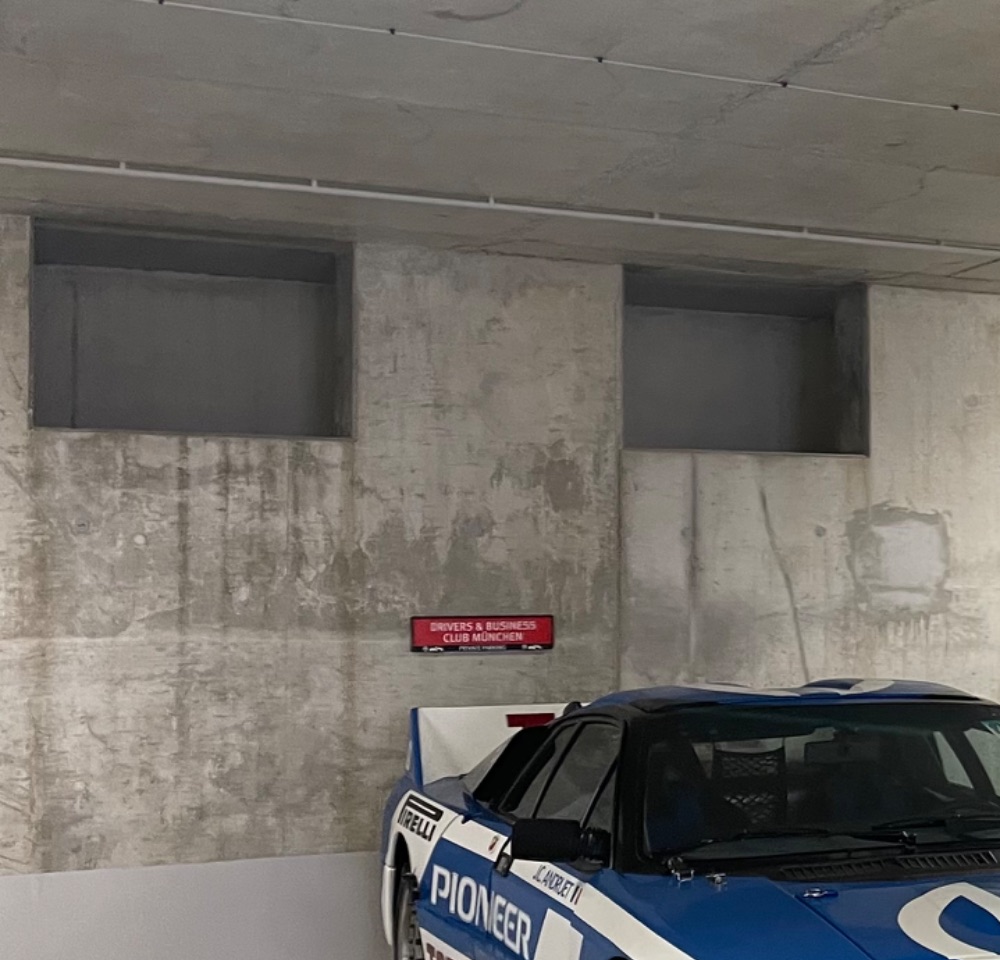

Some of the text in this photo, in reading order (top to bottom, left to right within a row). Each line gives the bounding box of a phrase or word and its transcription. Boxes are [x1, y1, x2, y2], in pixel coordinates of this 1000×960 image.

[430, 620, 537, 632] DRIVERS & BUSINESS
[443, 631, 524, 643] CLUB MÜNCHEN
[397, 794, 444, 842] PIRELLI
